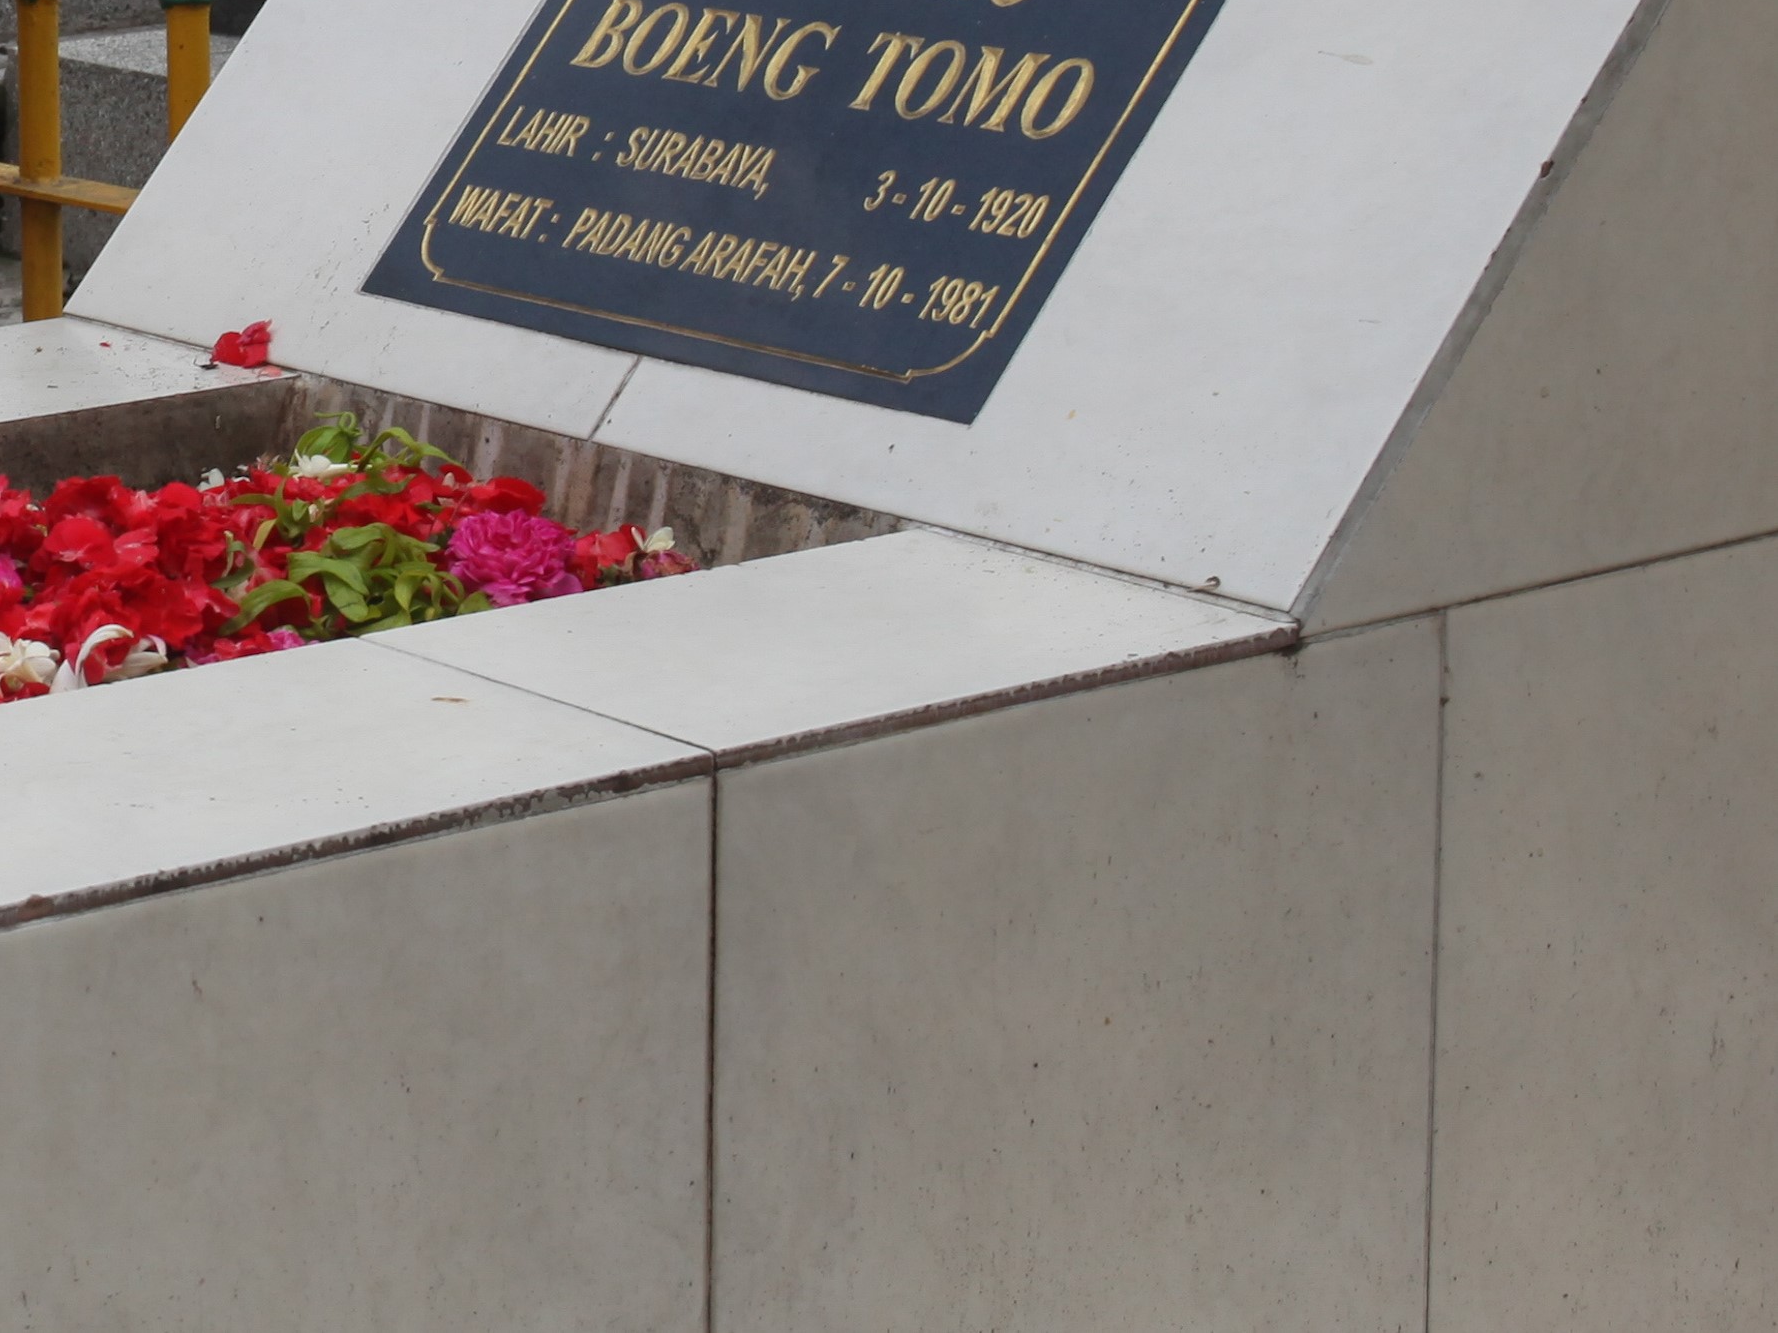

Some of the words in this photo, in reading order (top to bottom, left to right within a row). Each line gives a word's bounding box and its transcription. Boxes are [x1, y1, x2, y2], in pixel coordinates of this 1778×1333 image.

[848, 31, 1096, 141] TOMO
[496, 104, 590, 157] LAHIR
[615, 126, 776, 200] SURABAYA,
[562, 207, 692, 268] PADANG
[678, 230, 818, 302] ARAFAH,
